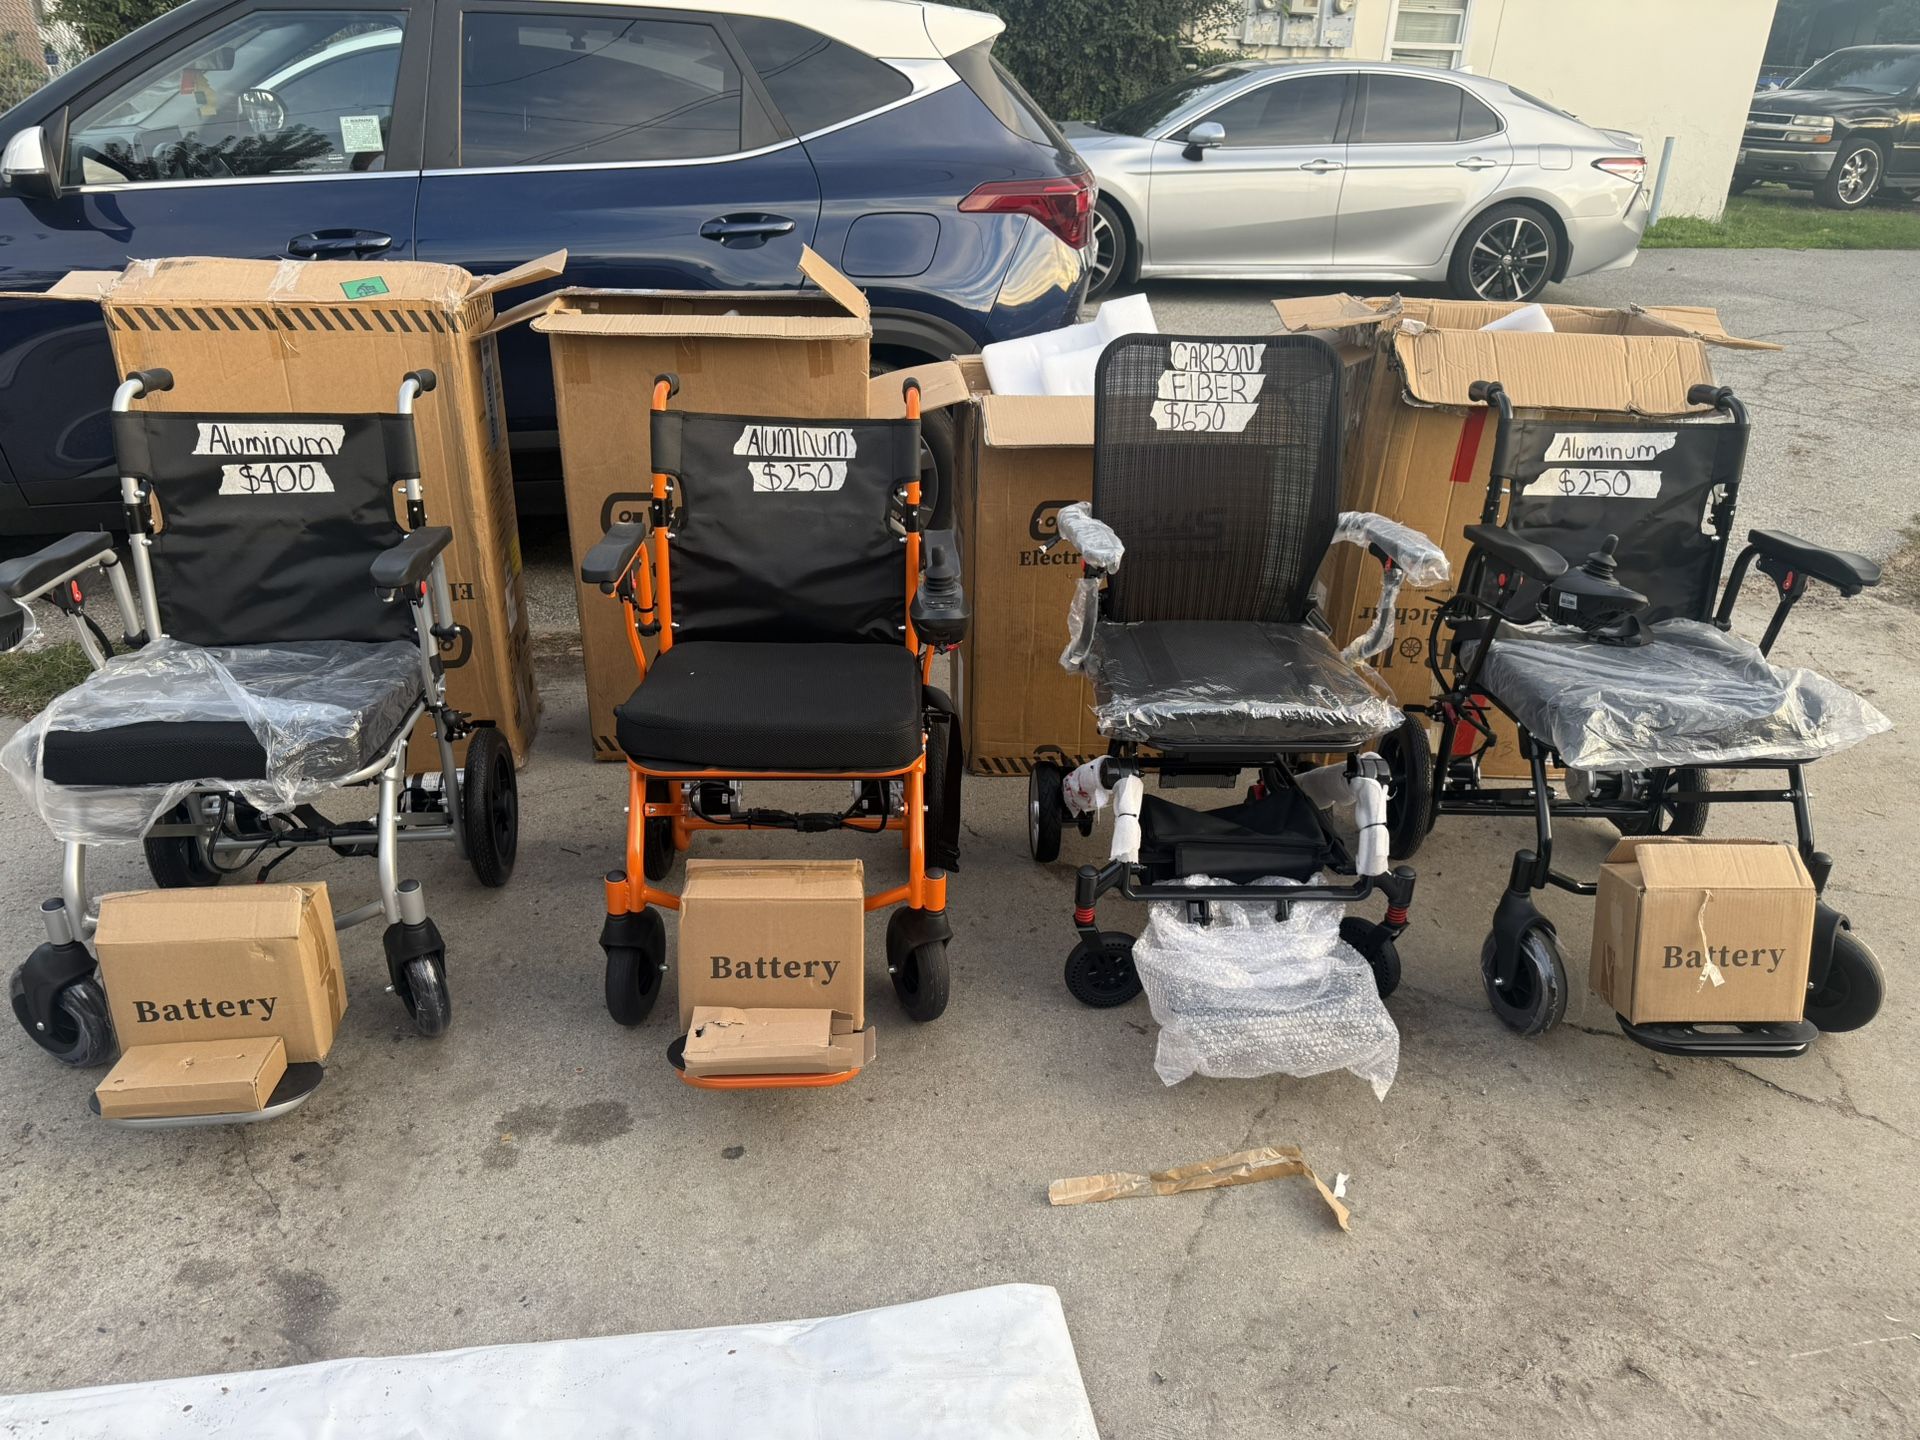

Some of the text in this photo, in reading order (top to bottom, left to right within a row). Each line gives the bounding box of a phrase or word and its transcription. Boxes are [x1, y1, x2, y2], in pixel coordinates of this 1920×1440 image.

[1174, 342, 1254, 372] CARBON
[1172, 373, 1248, 403] FIBER
[1161, 403, 1225, 431] $650
[210, 424, 336, 455] Aluminum
[1558, 437, 1657, 460] Aluminum
[239, 464, 316, 494] $400
[755, 462, 833, 492] $250
[1558, 468, 1631, 496] $250
[1019, 550, 1082, 566] Electr
[710, 956, 841, 985] Battery
[132, 997, 278, 1023] Battery
